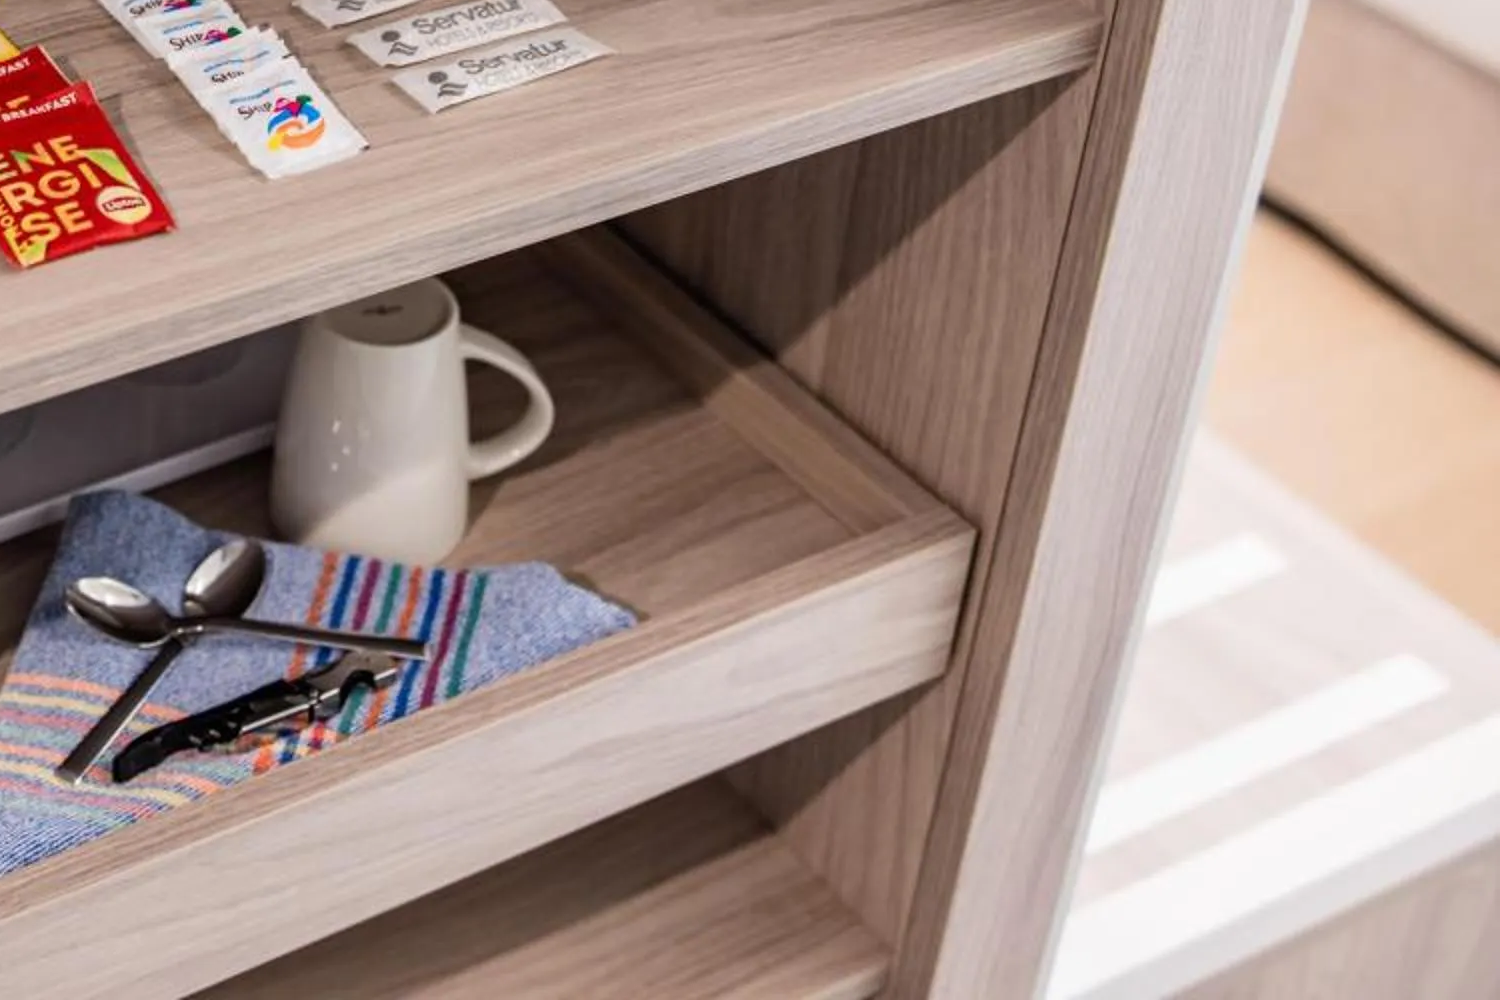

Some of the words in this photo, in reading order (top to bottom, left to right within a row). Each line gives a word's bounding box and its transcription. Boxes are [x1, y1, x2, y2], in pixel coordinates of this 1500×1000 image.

[457, 39, 569, 75] Servatur
[1, 91, 79, 122] BREAKFAST
[0, 163, 103, 213] RGI
[20, 201, 94, 242] SE
